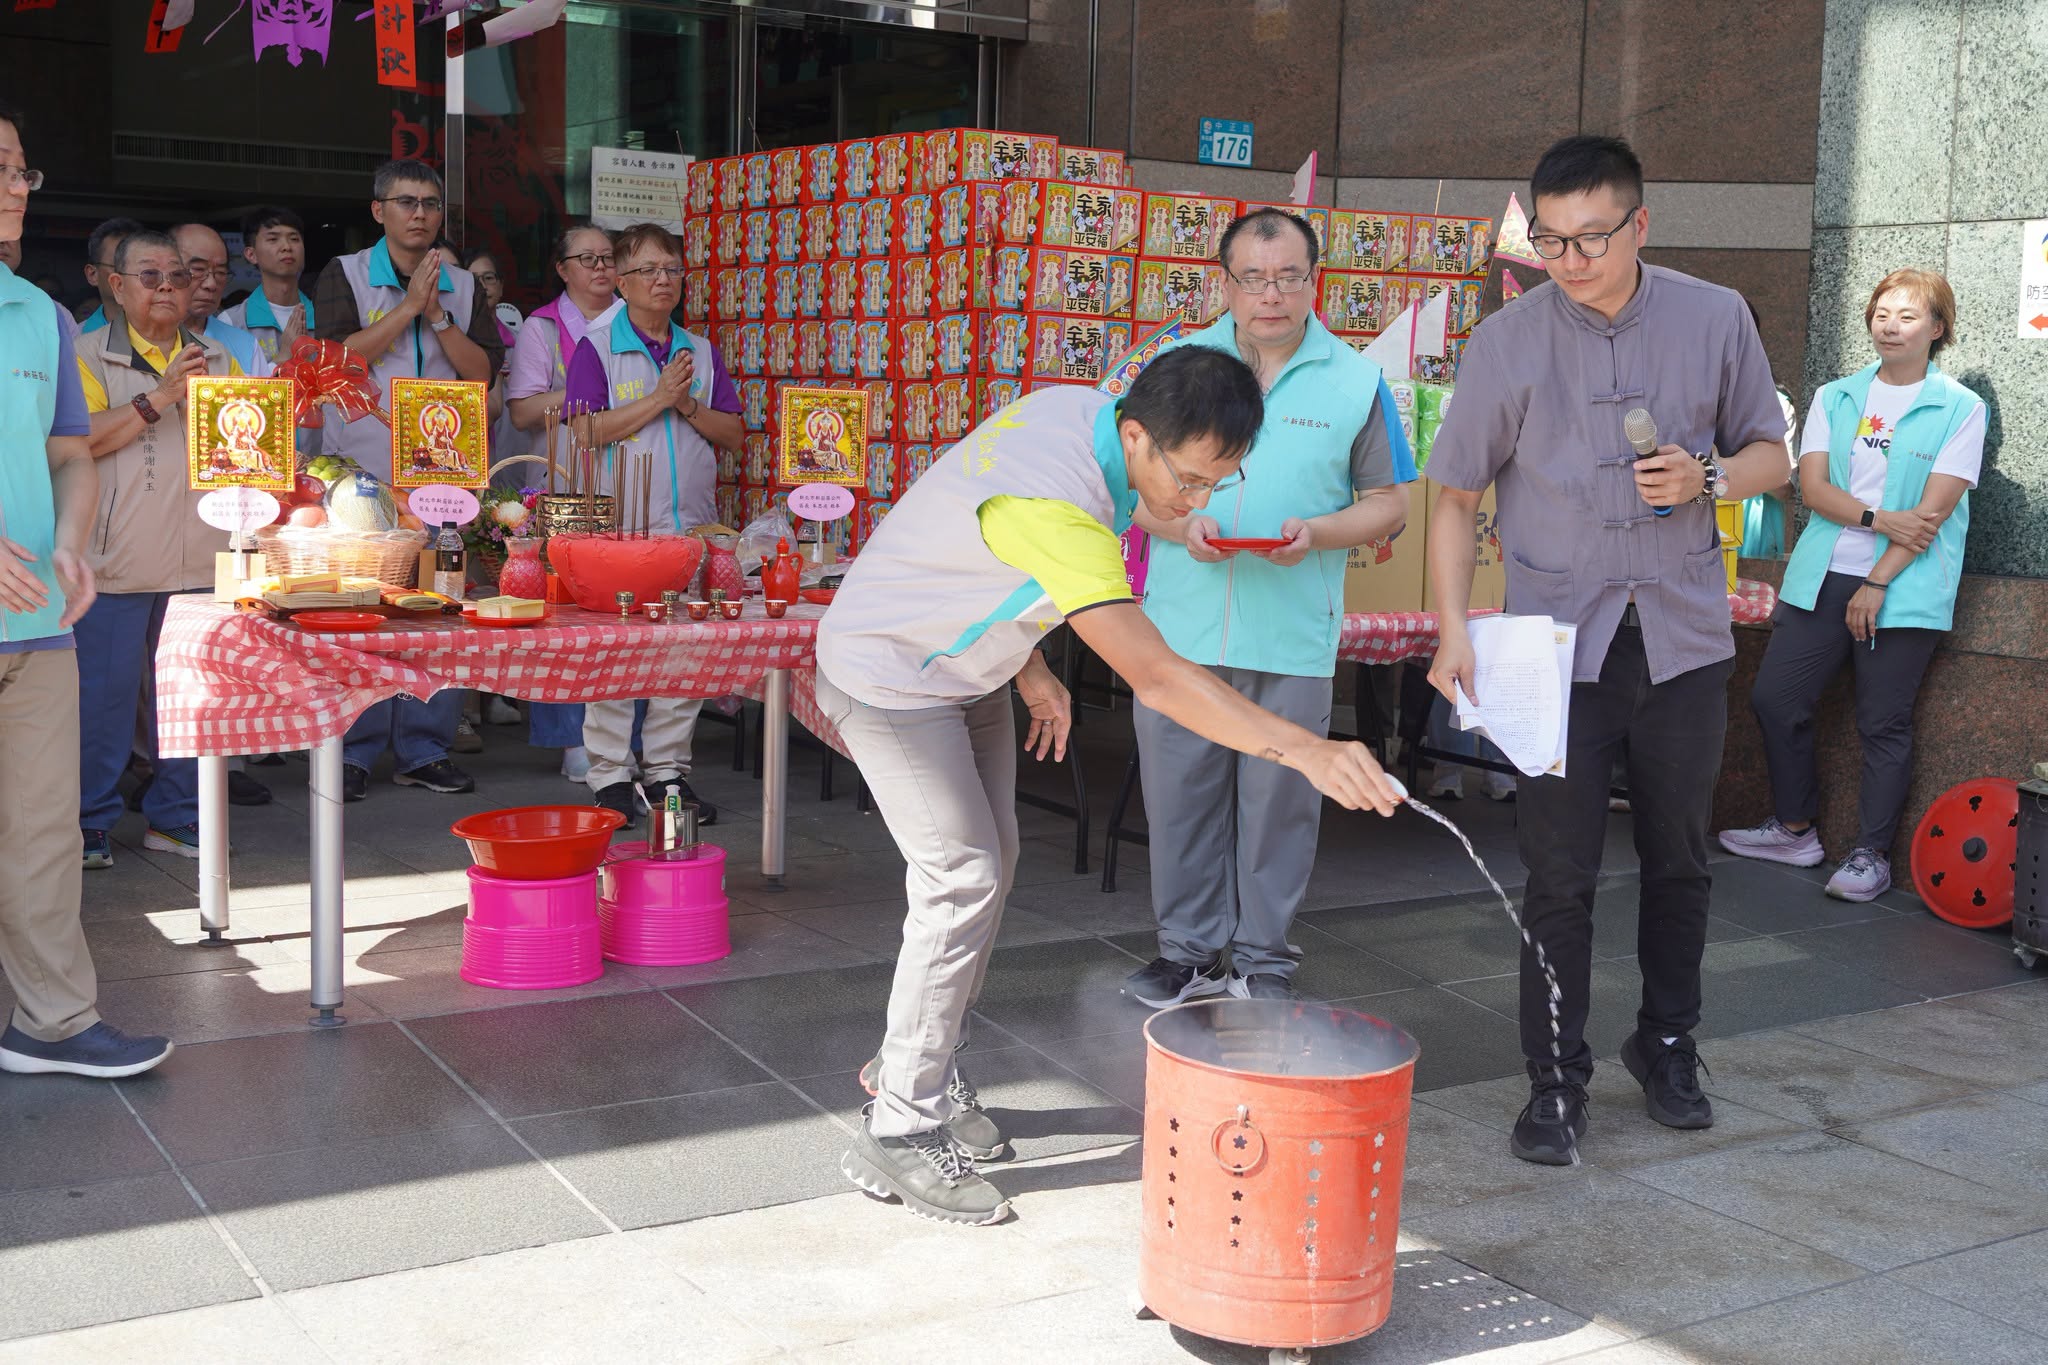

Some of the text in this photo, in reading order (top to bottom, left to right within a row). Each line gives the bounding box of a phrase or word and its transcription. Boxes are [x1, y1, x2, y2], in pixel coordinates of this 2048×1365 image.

[1217, 136, 1249, 161] 176
[1077, 193, 1112, 217] 全家
[1176, 204, 1209, 226] 全家
[1356, 220, 1385, 240] 全家
[1437, 225, 1466, 245] 全家
[1074, 232, 1108, 249] 平安福
[1174, 242, 1206, 257] 平安福
[1069, 259, 1105, 282] 全家
[1353, 255, 1382, 269] 平安福
[1435, 260, 1464, 272] 平安福
[1168, 270, 1202, 292] 全家
[1350, 281, 1381, 301] 全家
[1066, 298, 1101, 313] 平安福
[1347, 316, 1378, 330] 平安福
[1066, 326, 1103, 348] 全家
[1064, 363, 1099, 379] 平安福
[1290, 417, 1331, 430] 新莊區公所
